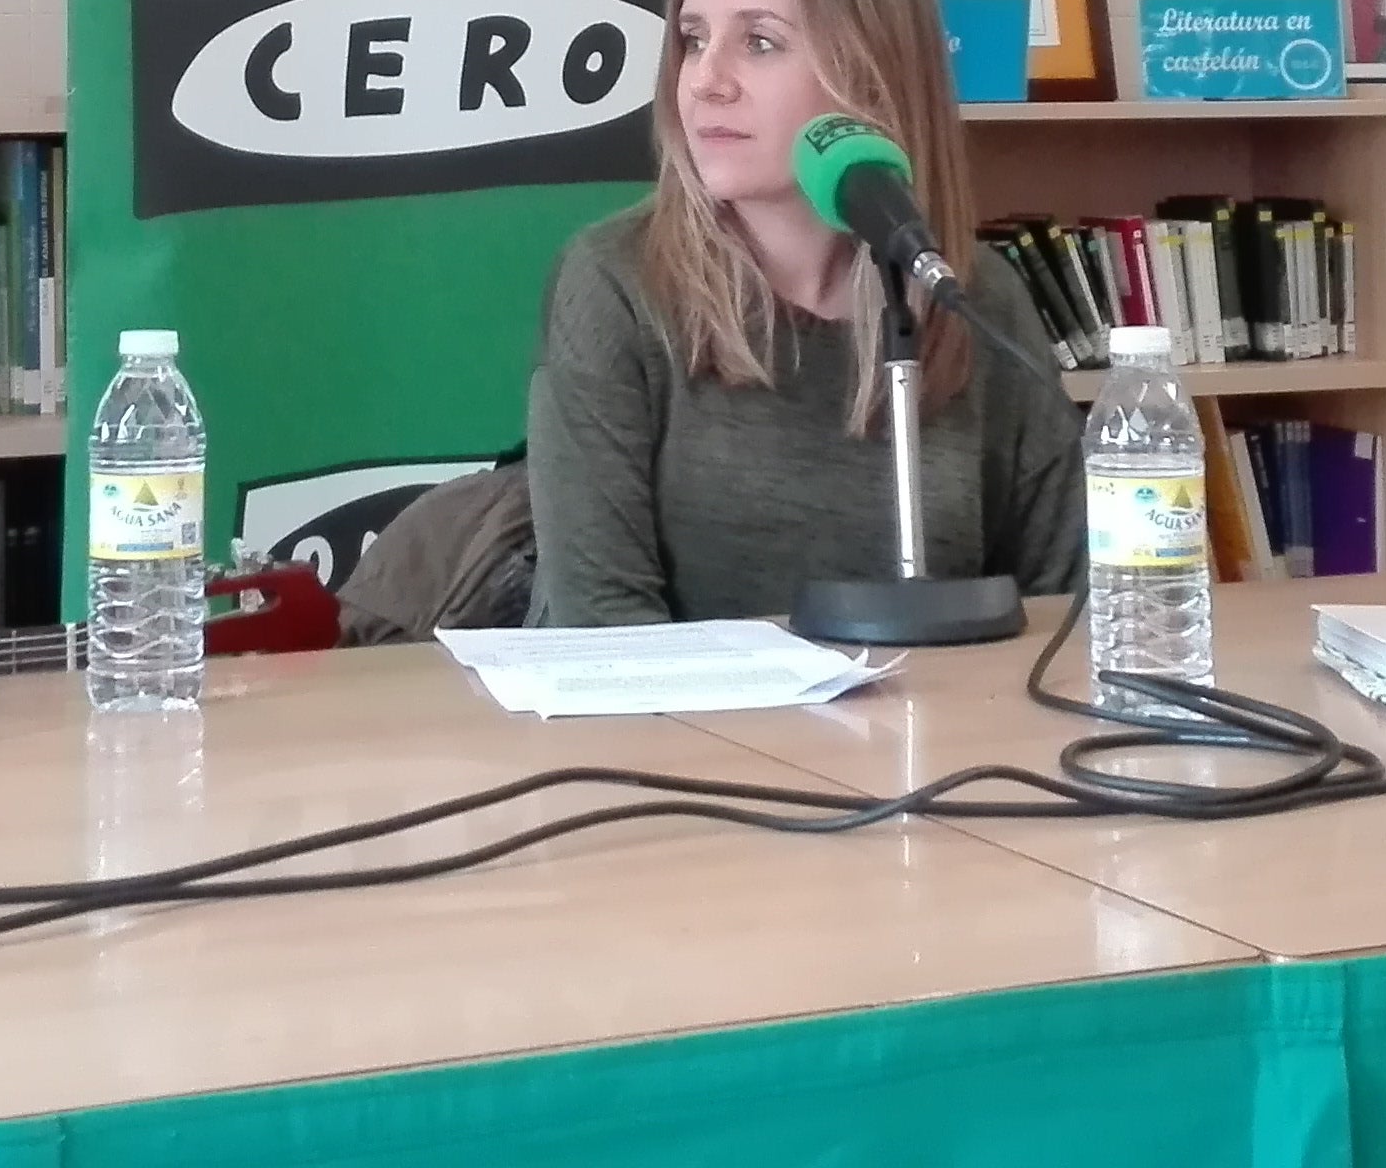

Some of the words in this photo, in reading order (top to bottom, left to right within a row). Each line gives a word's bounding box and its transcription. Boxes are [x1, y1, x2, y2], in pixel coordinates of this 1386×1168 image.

[1157, 8, 1280, 37] Literatura
[1285, 14, 1312, 30] en
[244, 15, 627, 122] CERO
[1163, 46, 1260, 72] castelán
[147, 502, 182, 526] SANA
